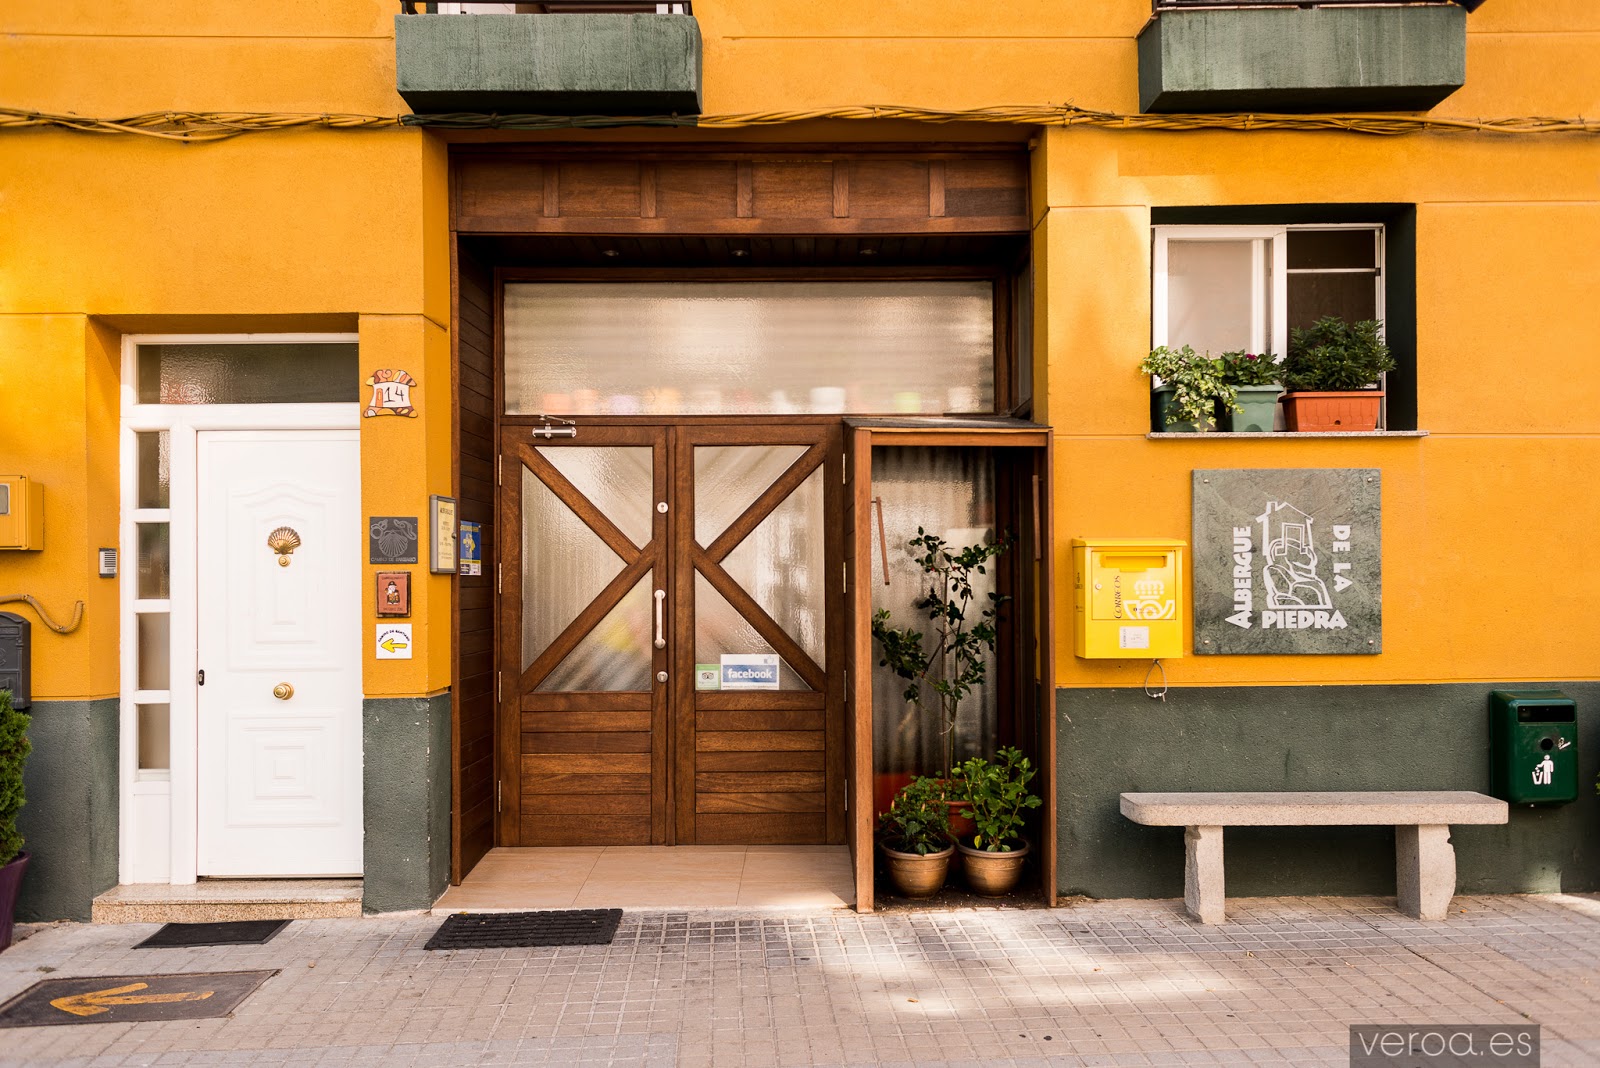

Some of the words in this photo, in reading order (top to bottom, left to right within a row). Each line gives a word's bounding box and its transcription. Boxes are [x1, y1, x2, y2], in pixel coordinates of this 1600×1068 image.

[384, 386, 404, 403] 14
[1332, 525, 1351, 552] DE
[1225, 526, 1253, 630] ALBERGUE
[1333, 562, 1353, 592] LA
[1114, 575, 1122, 619] CORREOS
[1261, 609, 1348, 630] PIEDRA
[727, 668, 773, 679] facebook
